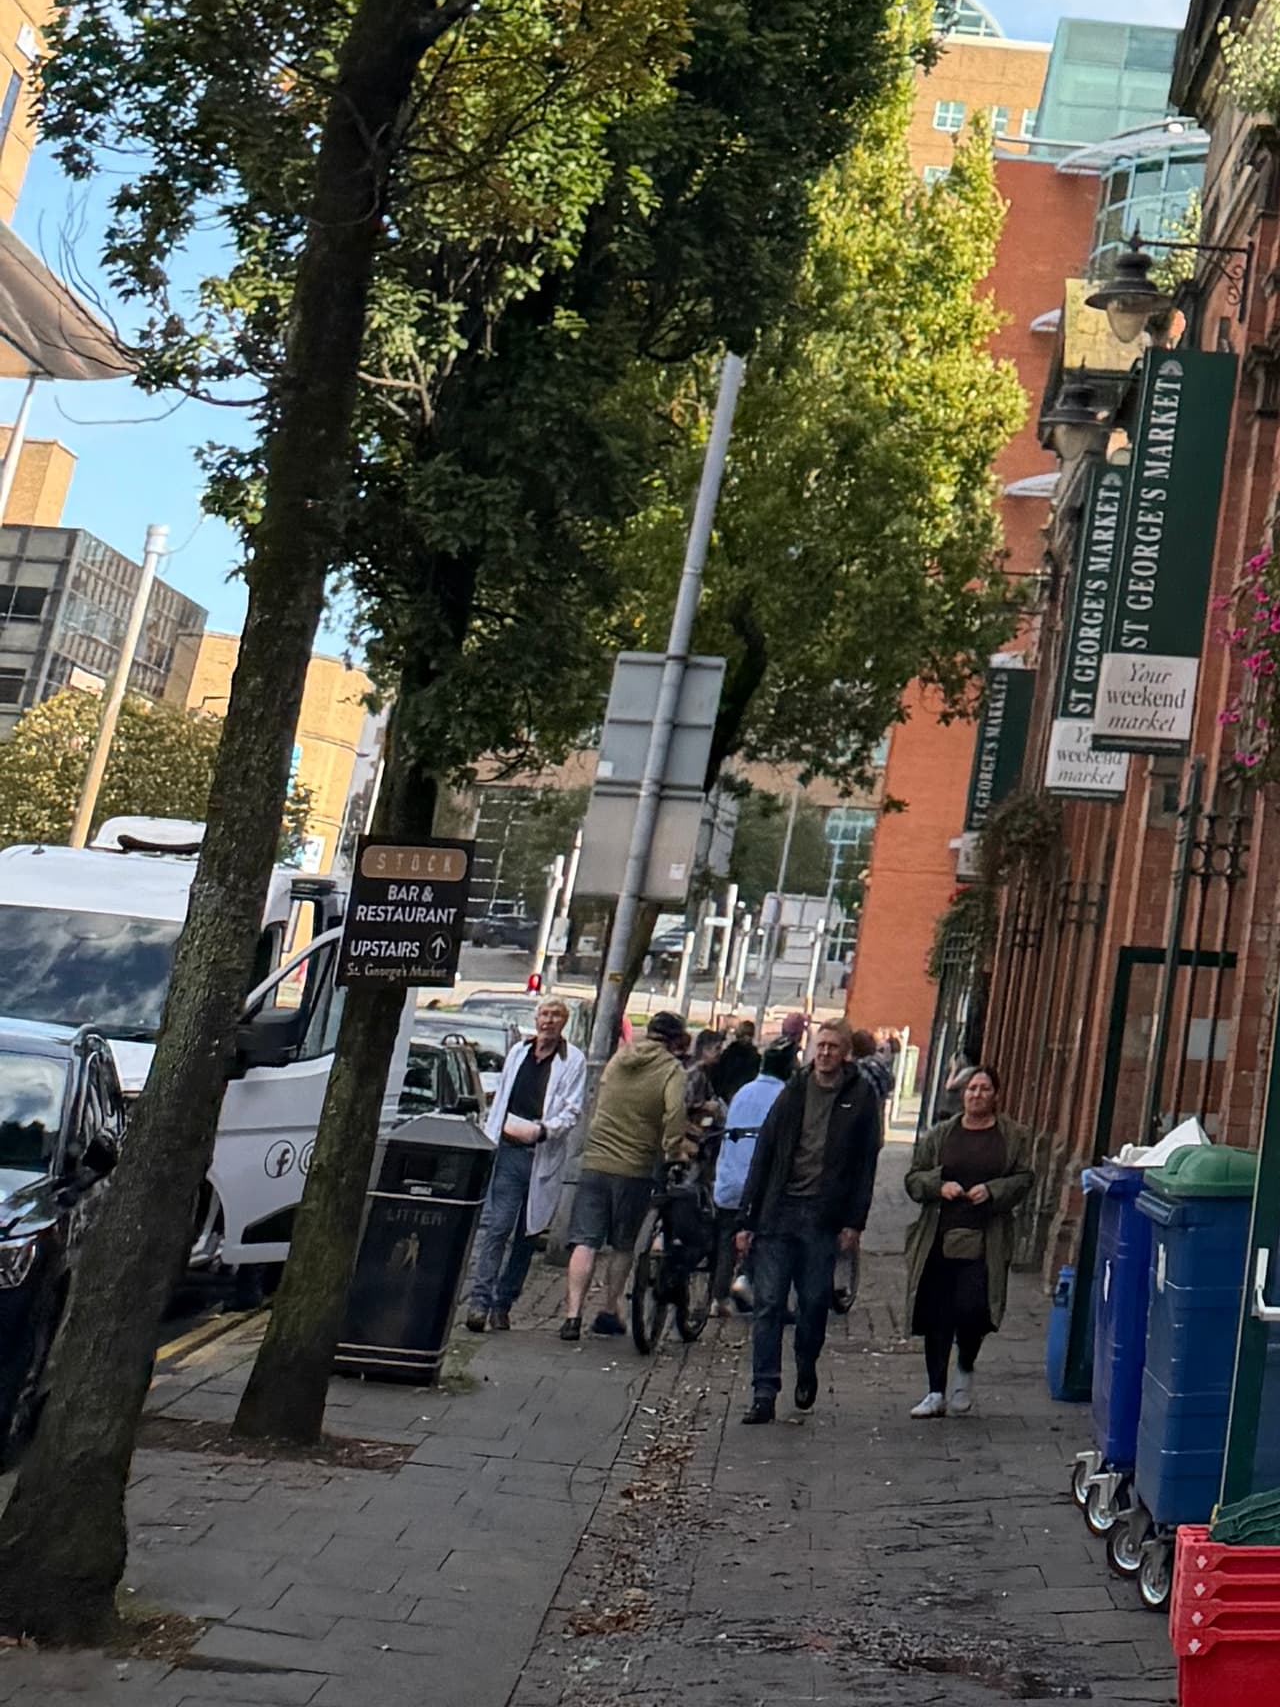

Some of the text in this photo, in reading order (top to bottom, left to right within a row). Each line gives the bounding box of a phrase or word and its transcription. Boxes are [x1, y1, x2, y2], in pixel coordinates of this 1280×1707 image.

[1122, 378, 1181, 652] ST GEORGE'S MARKET
[1069, 488, 1122, 715] ST GEORGE'S MARKET
[1128, 661, 1172, 684] Your
[1107, 685, 1186, 709] weekend
[1108, 710, 1176, 732] market
[1058, 767, 1115, 785] market
[376, 852, 454, 874] STOCK
[388, 884, 434, 903] BAR &
[356, 905, 457, 925] RESTAURANT
[350, 939, 420, 958] UPSTAIRS
[386, 1207, 443, 1226] LITTER
